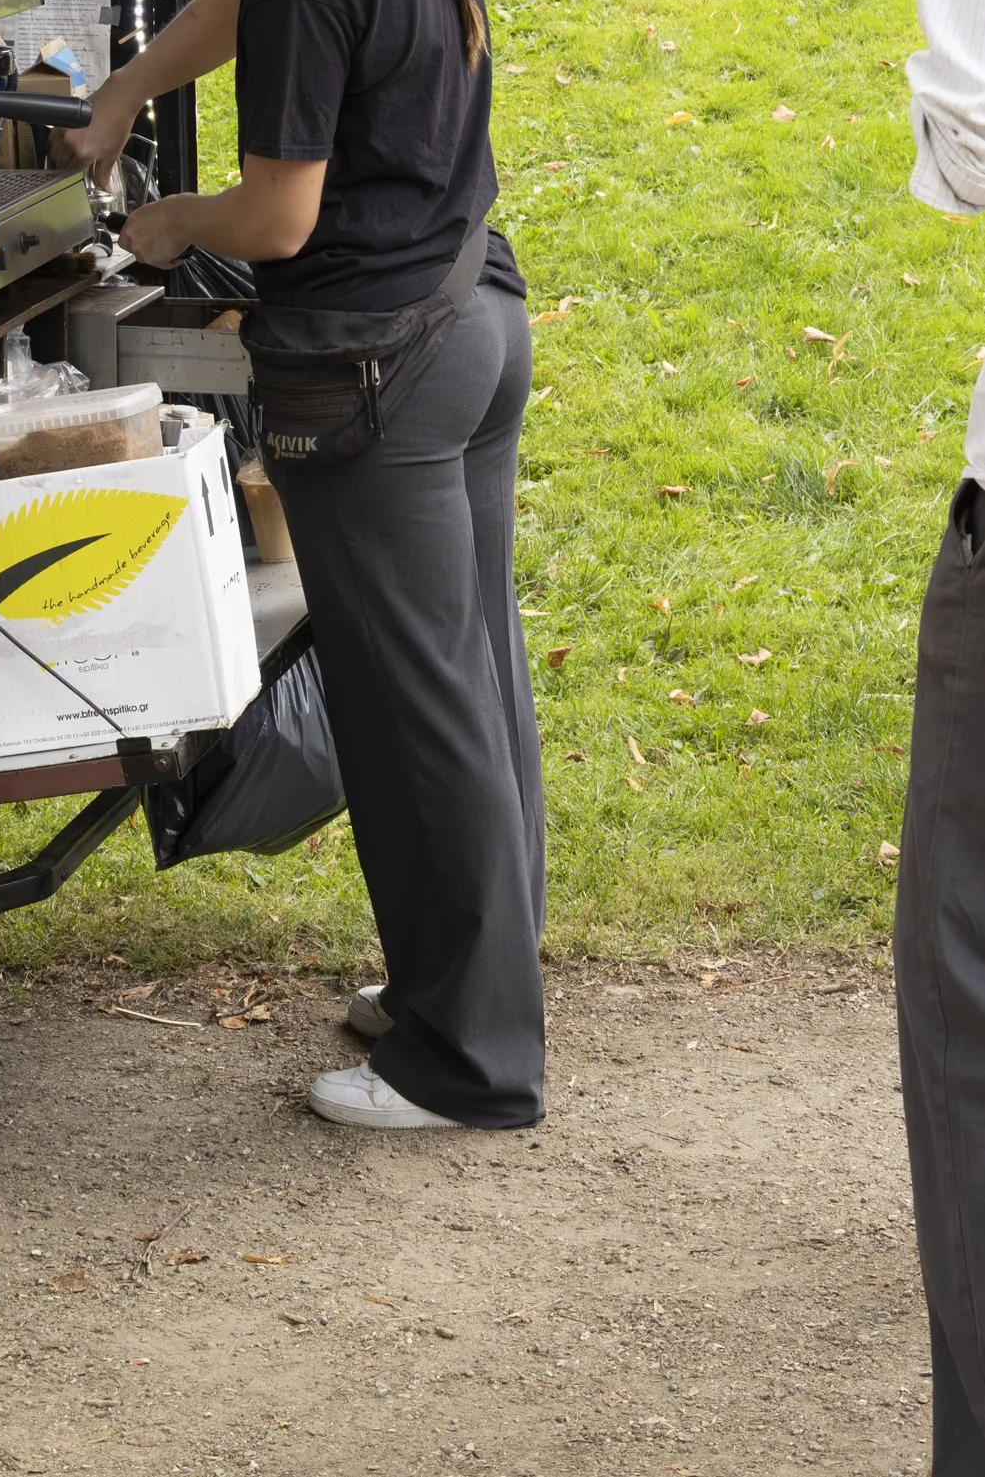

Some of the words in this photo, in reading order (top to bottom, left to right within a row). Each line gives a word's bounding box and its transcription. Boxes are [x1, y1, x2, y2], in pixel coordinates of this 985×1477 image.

[267, 431, 318, 460] ASIVIK
[42, 598, 64, 612] the
[68, 560, 128, 604] handmade
[129, 511, 172, 560] beverage
[78, 662, 109, 674] spitiko
[56, 702, 149, 723] www.bfrehspitiko.gr
[2, 740, 22, 748] Avenue
